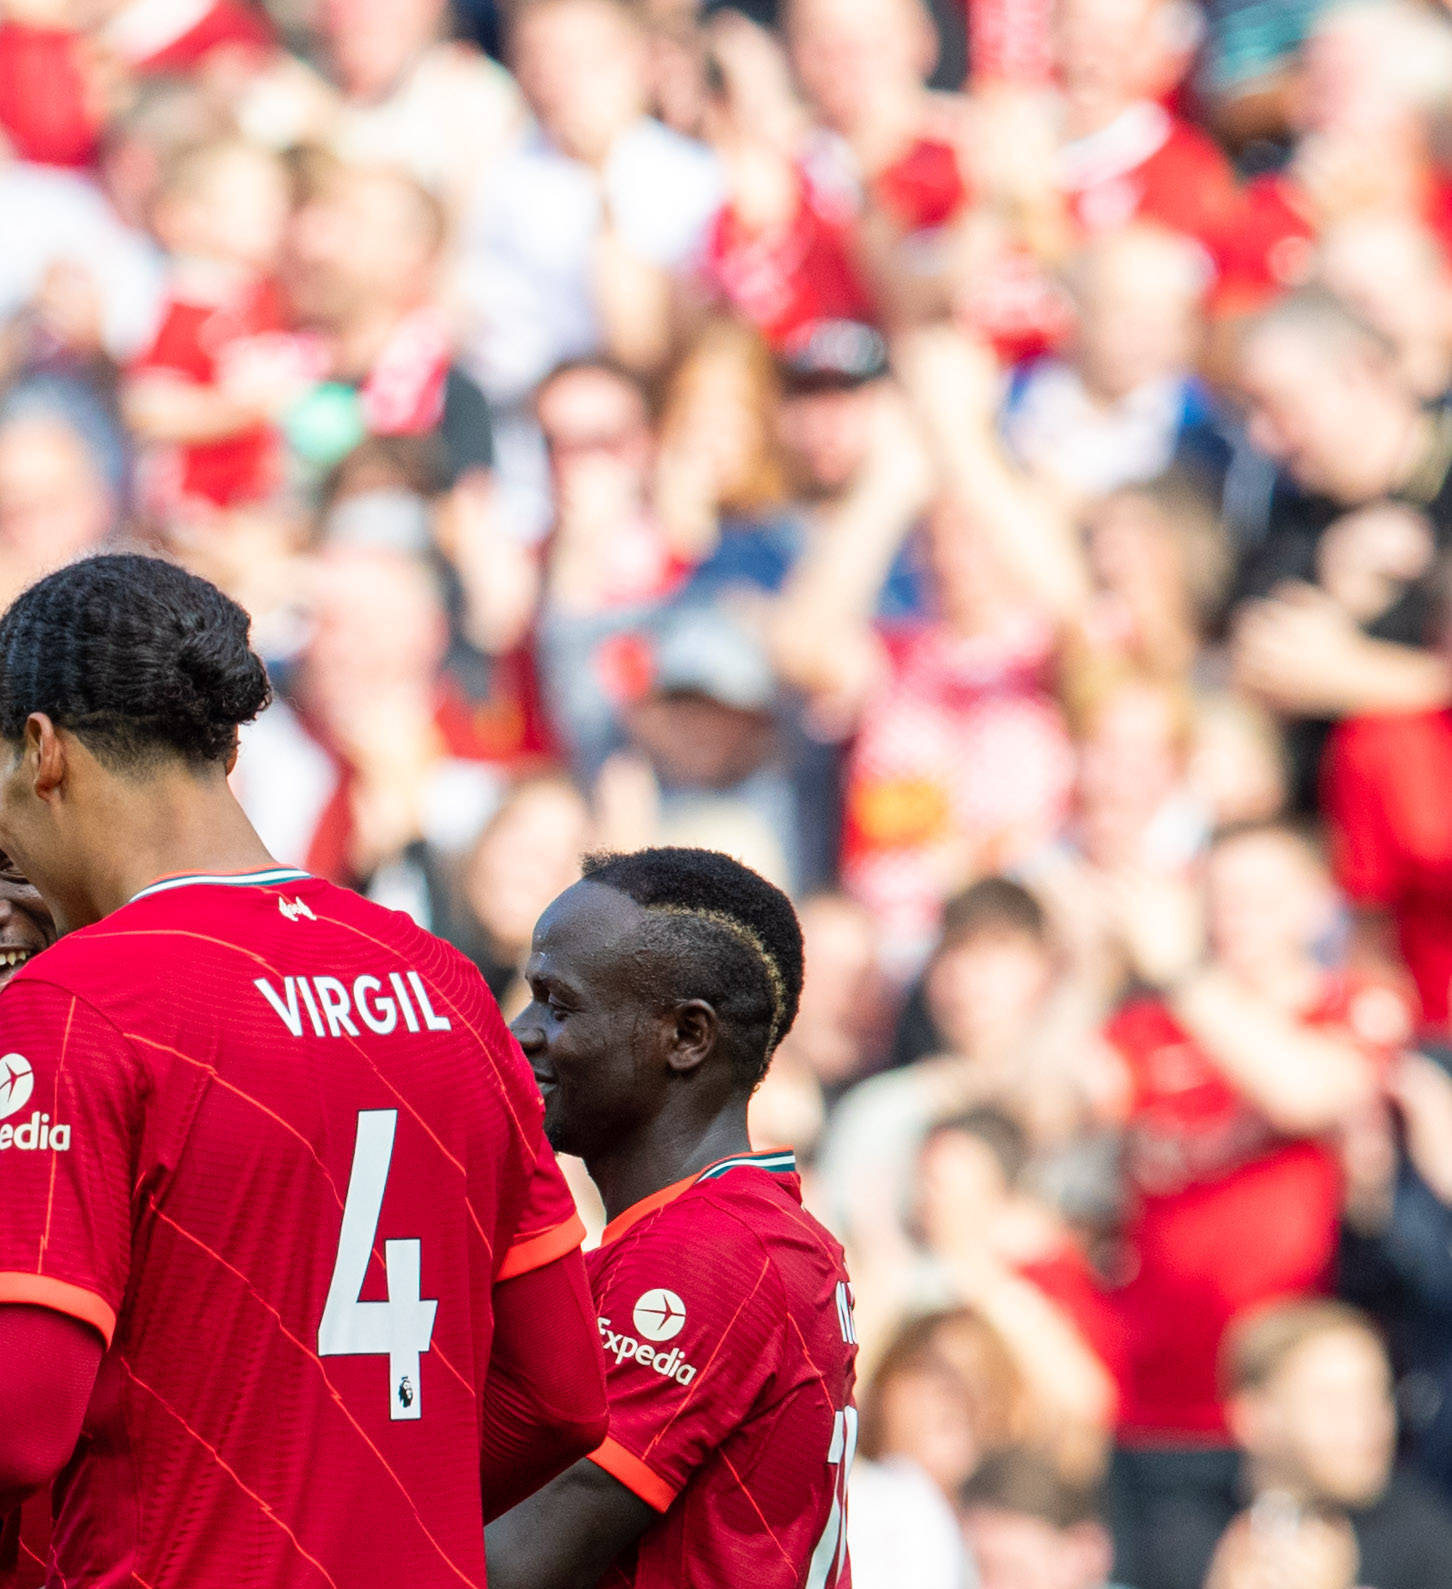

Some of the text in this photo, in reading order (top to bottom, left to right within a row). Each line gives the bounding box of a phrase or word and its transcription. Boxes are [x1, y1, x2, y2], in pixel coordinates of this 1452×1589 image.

[255, 971, 451, 1038] VIRGIL
[318, 1108, 438, 1420] 4
[597, 1317, 697, 1386] Expedia
